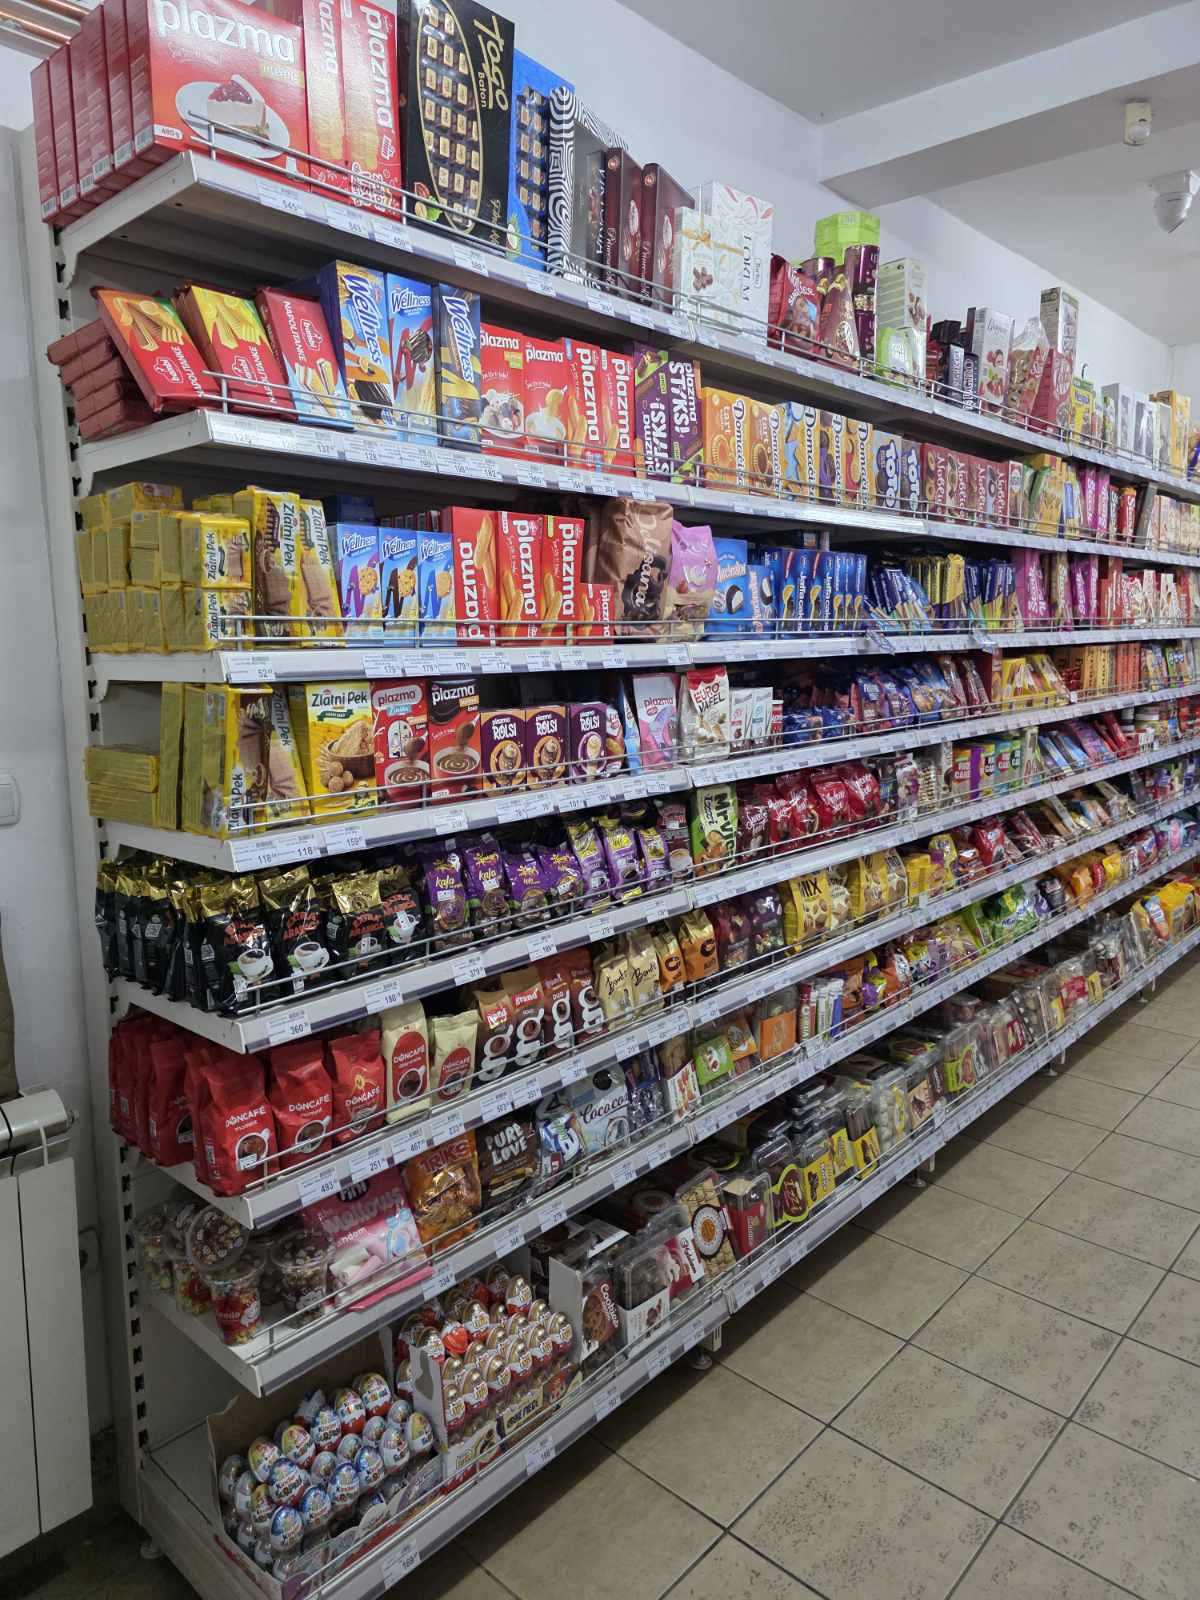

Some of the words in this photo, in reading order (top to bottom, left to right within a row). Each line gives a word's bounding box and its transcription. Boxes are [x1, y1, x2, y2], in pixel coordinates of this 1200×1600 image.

[154, 0, 296, 64] plazma
[319, 0, 338, 74] azma
[360, 5, 392, 128] plazma
[478, 71, 487, 108] Baton
[391, 287, 431, 313] Wellness
[341, 273, 385, 366] Wellness
[442, 295, 477, 383] Wellness
[526, 347, 563, 363] plazma
[576, 348, 600, 441] plazma
[612, 359, 631, 449] plazma
[684, 362, 697, 421] plazma
[283, 503, 295, 541] Zlatni
[311, 507, 327, 544] Zlatni
[320, 546, 330, 565] Pek
[206, 531, 216, 550] Pek
[342, 533, 376, 557] Wellness
[383, 536, 417, 559] Wellness
[420, 538, 451, 561] Wellness
[284, 544, 295, 567] Pek
[512, 519, 537, 615] plazma
[558, 523, 578, 615] plazma
[311, 692, 345, 707] Zlatni
[347, 691, 368, 704] Pek
[378, 690, 416, 706] plazma
[432, 685, 475, 706] plazma
[644, 697, 673, 708] plazma
[694, 683, 720, 702] EURO
[279, 725, 291, 746] Pek
[232, 773, 244, 796] Pek
[491, 1135, 528, 1166] LOVE
